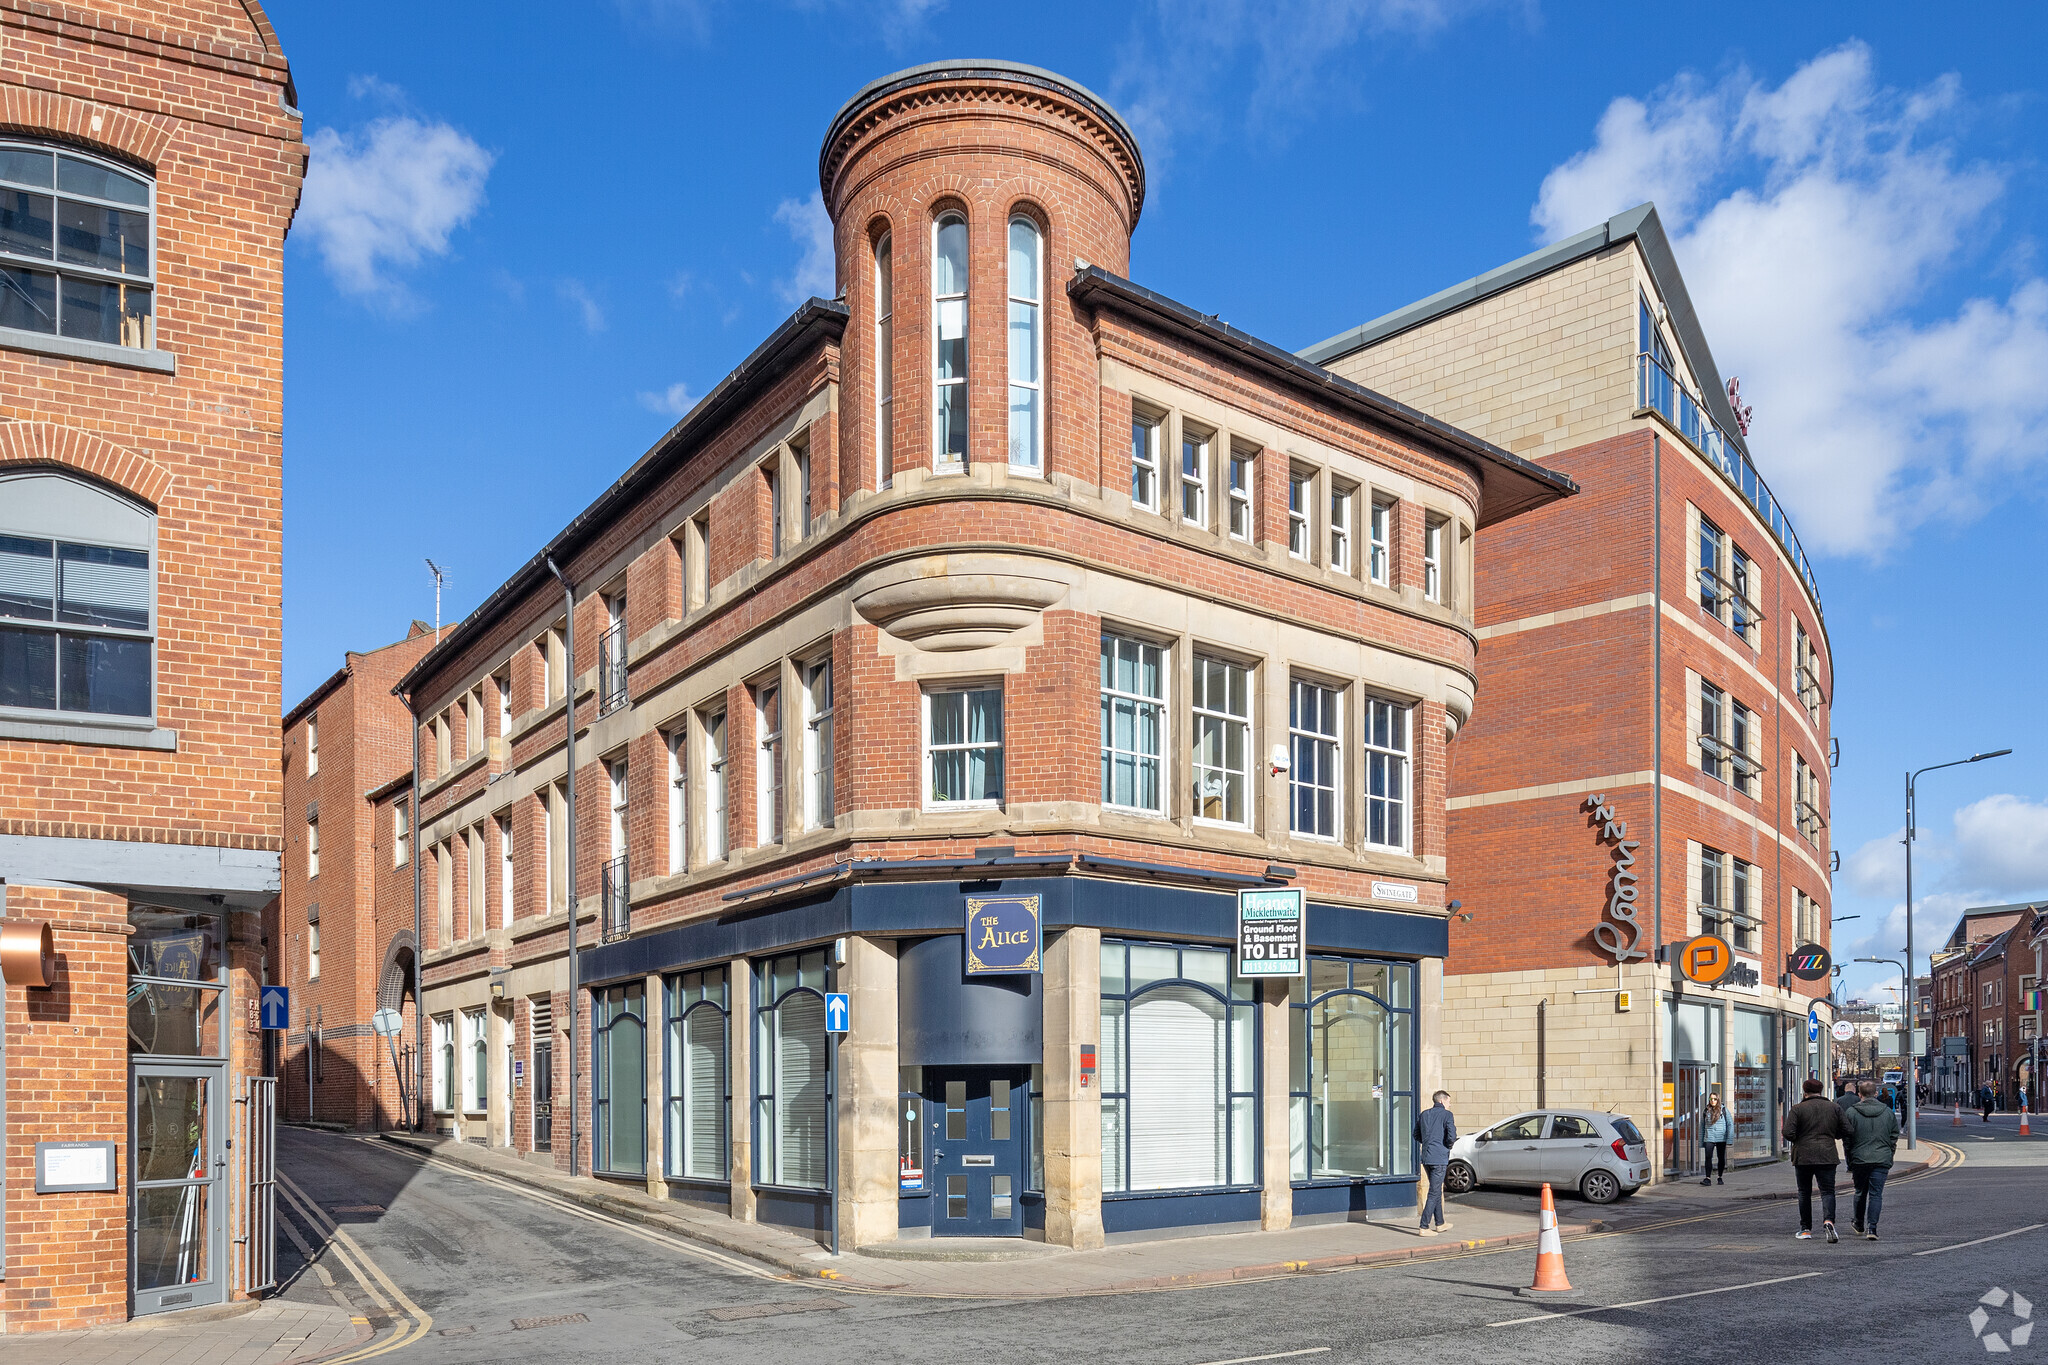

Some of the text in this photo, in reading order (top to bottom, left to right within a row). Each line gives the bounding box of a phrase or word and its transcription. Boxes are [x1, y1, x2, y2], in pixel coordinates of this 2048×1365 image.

[1376, 885, 1413, 899] SWINEGATE
[1245, 894, 1297, 910] Heaney
[1245, 906, 1297, 918] Micklethwaite
[980, 916, 999, 926] THE
[1243, 924, 1298, 934] Ground Floor
[977, 926, 1029, 950] ALICE
[1244, 933, 1297, 943] & Basement
[1243, 943, 1298, 960] TO LET
[1244, 961, 1297, 972] 0113 245 1622
